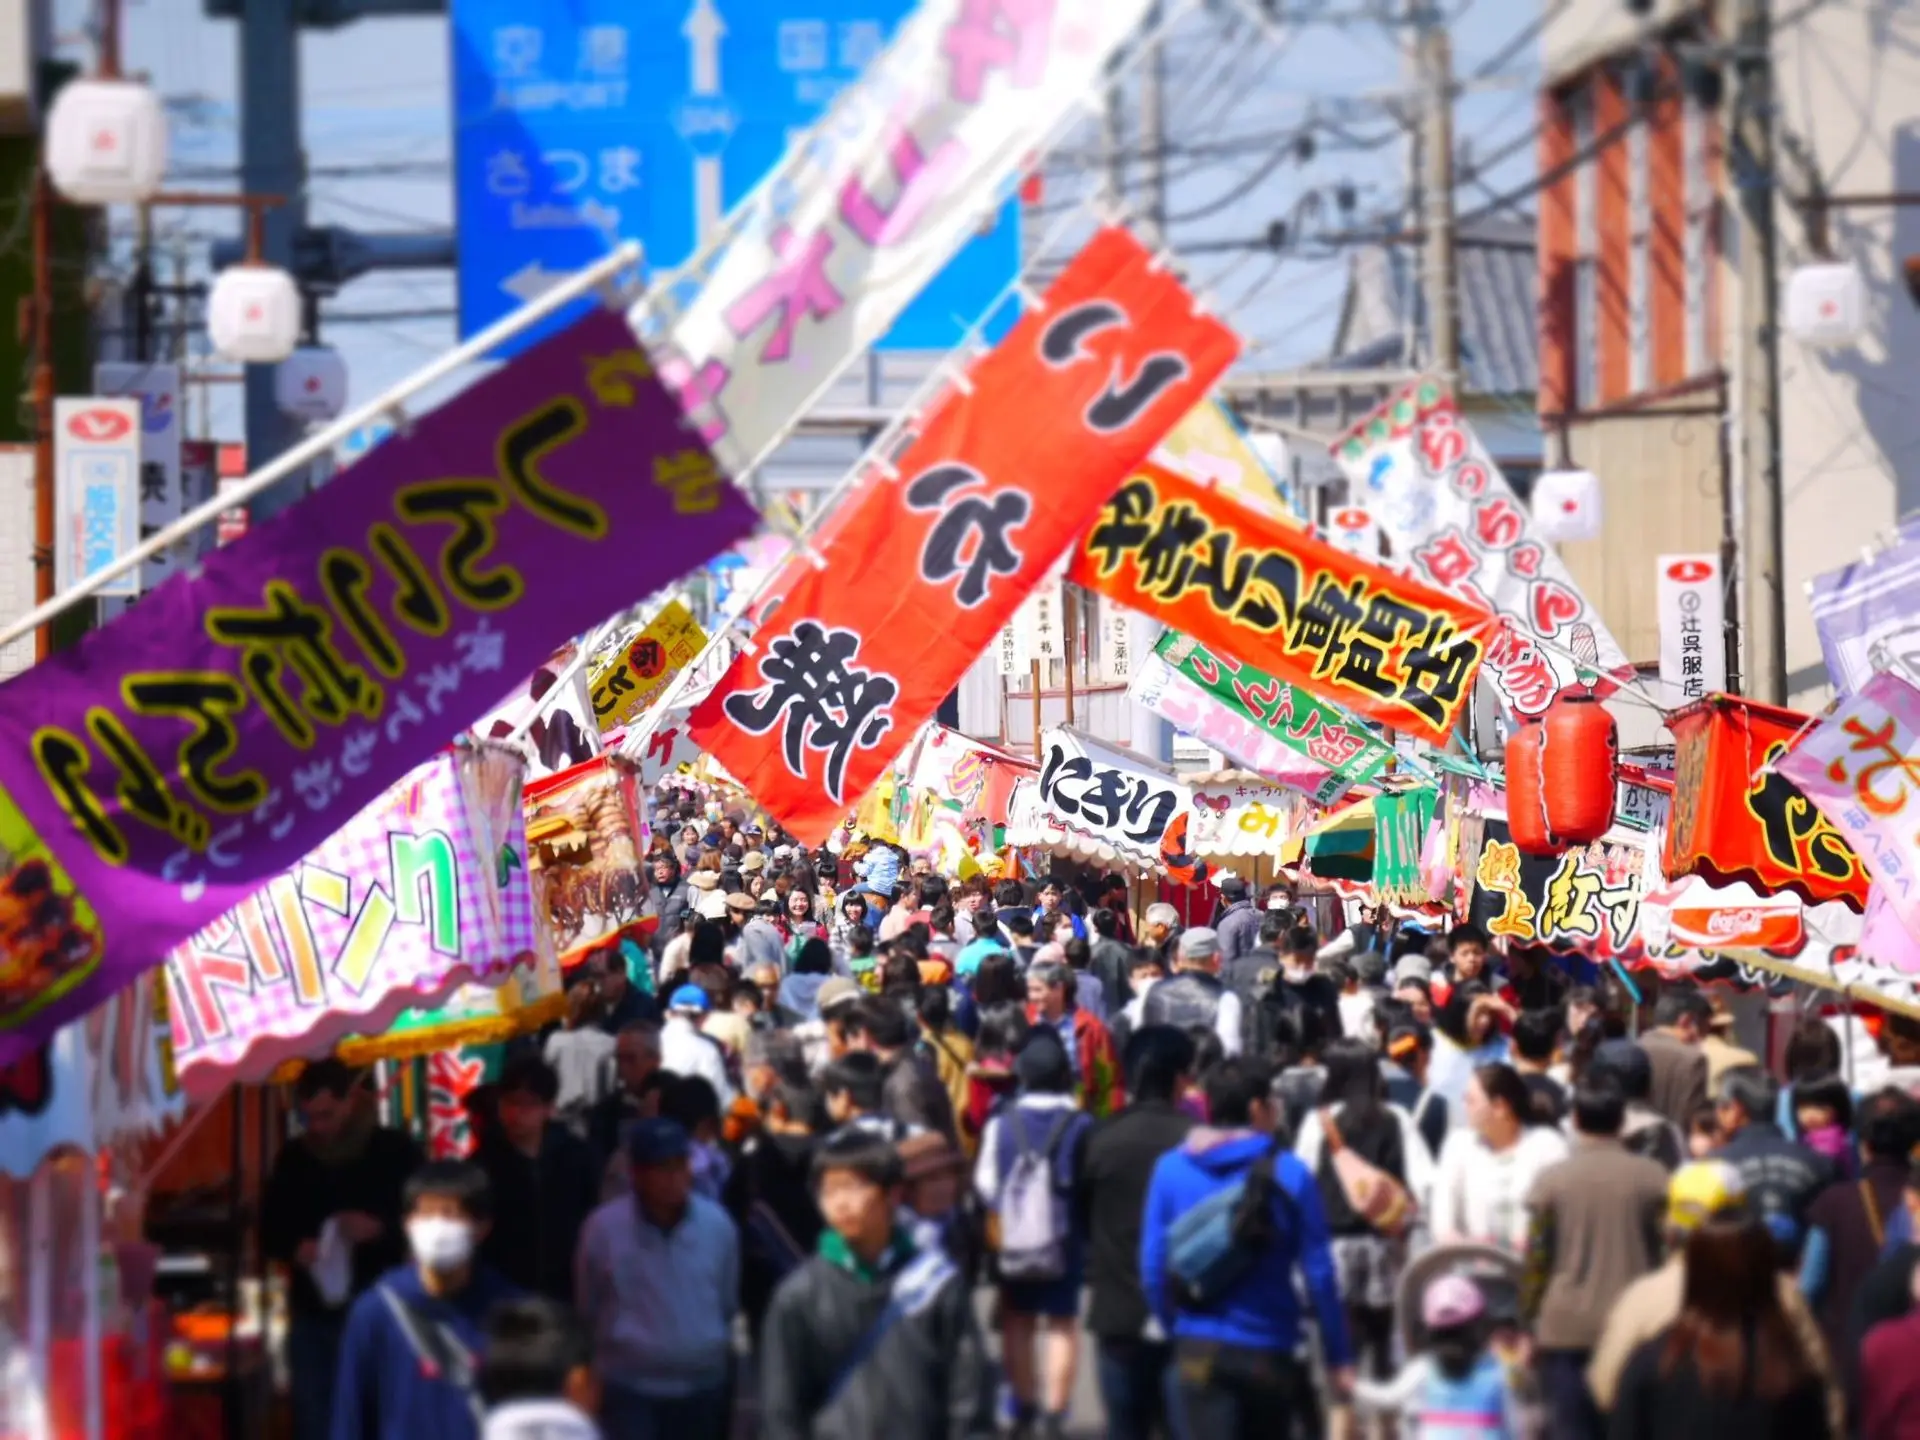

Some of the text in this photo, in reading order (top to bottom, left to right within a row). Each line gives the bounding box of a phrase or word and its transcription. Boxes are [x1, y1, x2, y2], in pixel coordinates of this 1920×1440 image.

[33, 396, 610, 866] しんこだんご
[1086, 478, 1485, 733] やきとり専門店
[1040, 744, 1177, 845] にぎり
[1191, 648, 1366, 766] りんご飴
